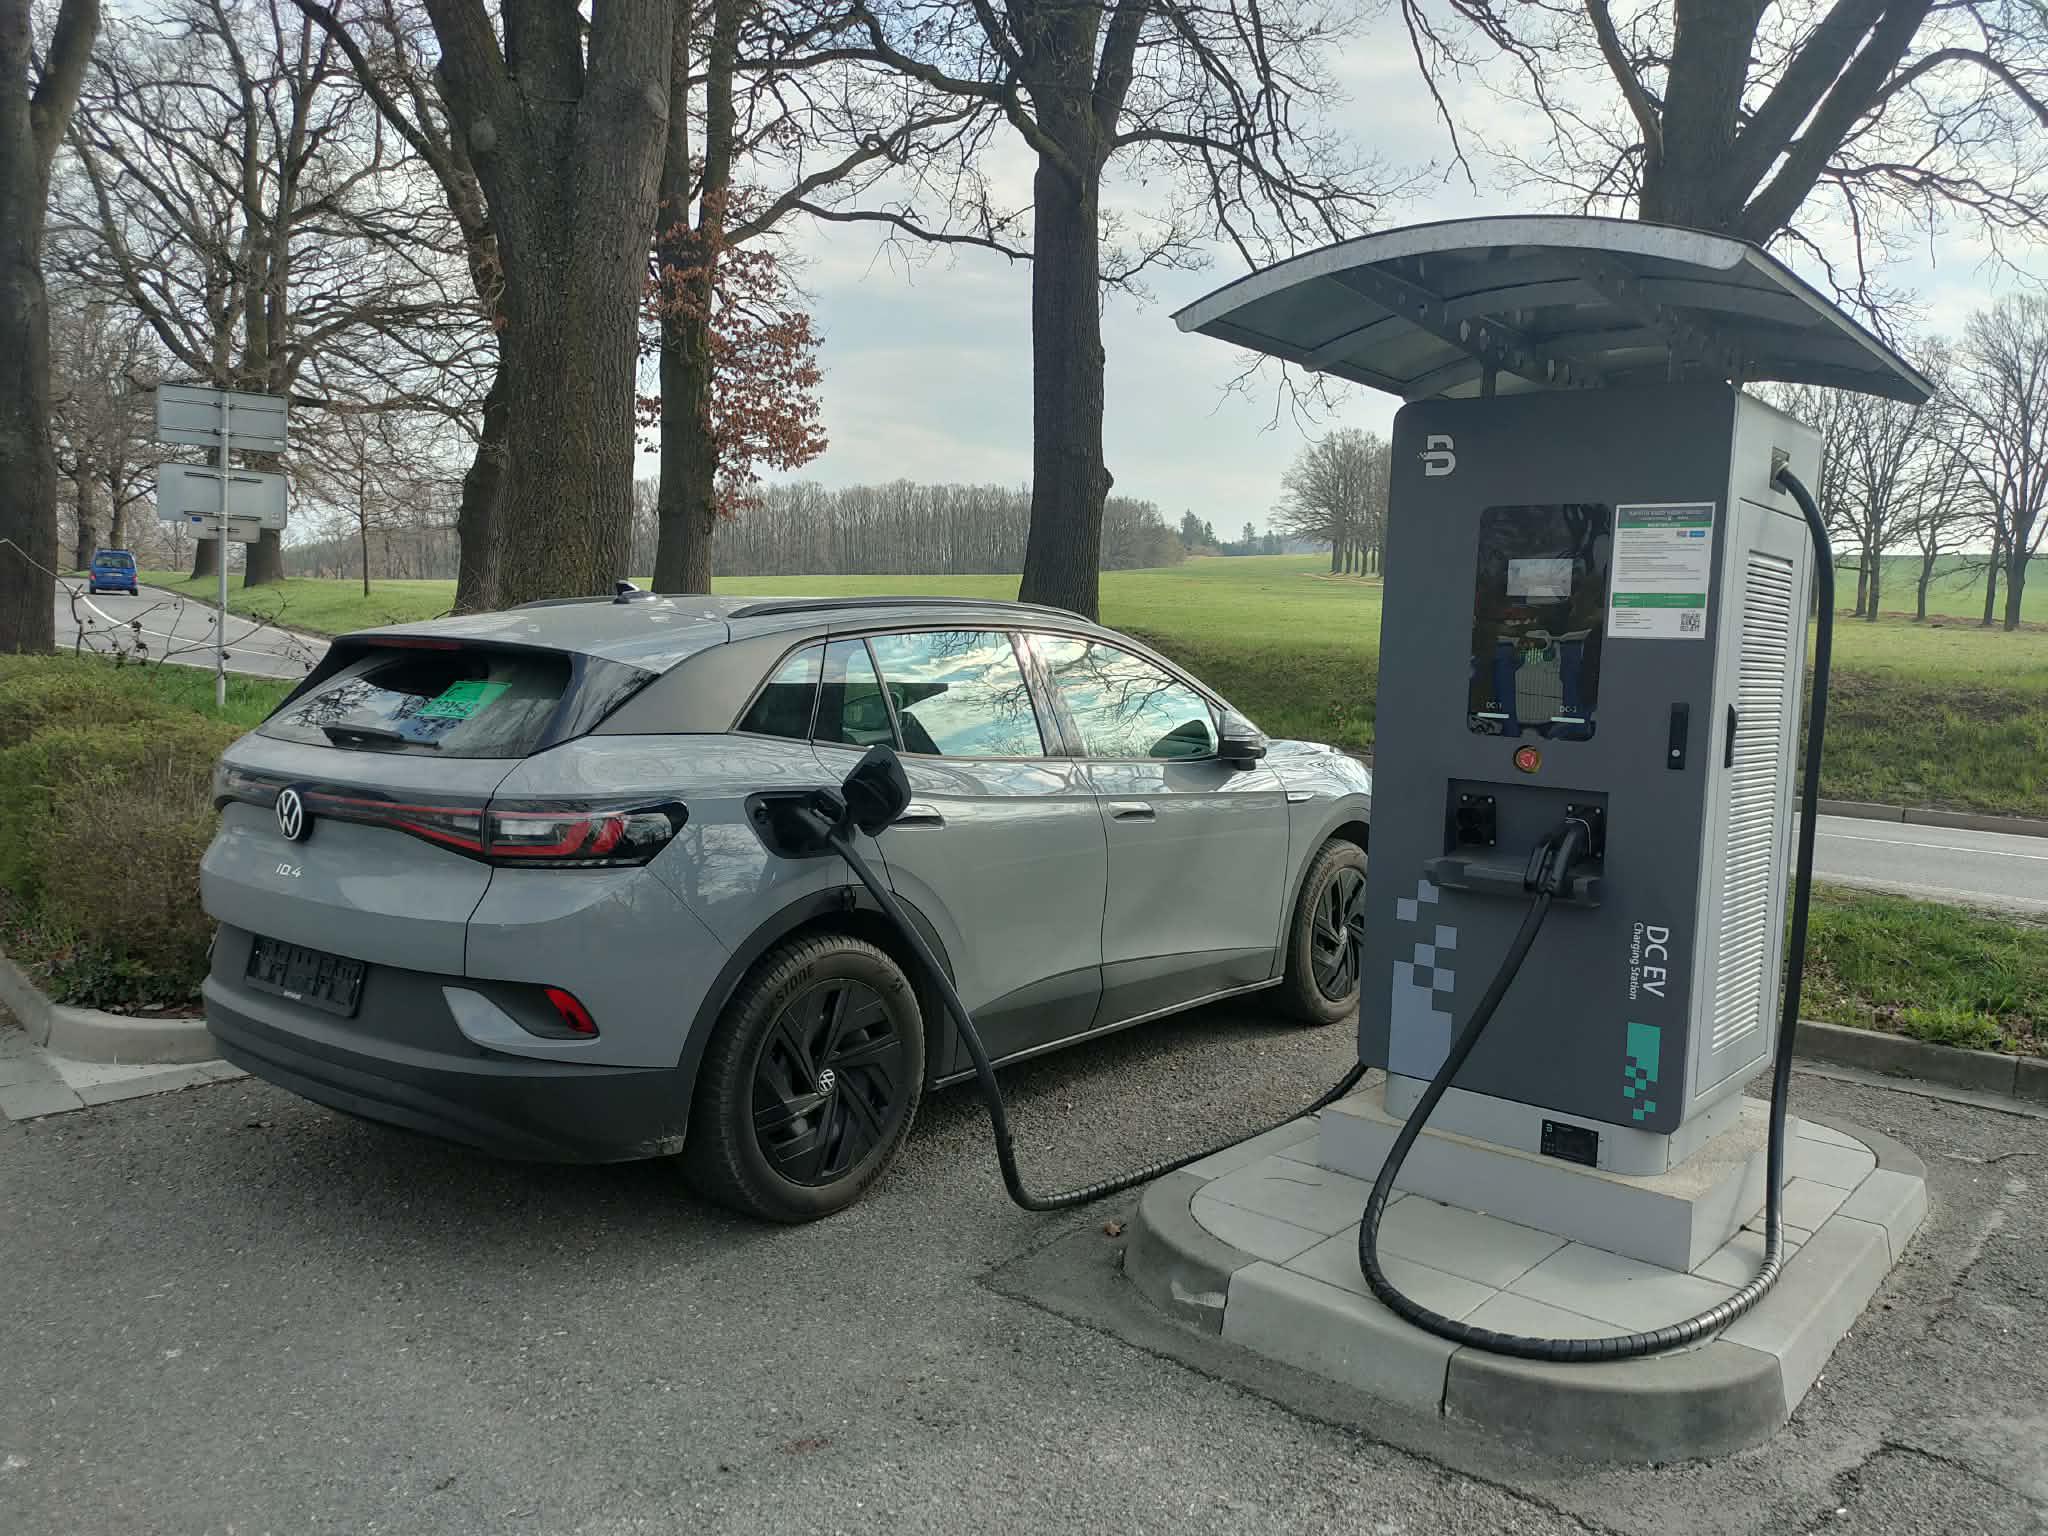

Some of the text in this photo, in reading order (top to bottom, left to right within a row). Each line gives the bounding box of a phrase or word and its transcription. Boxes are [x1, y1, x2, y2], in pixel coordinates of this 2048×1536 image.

[1628, 921, 1644, 1000] Charging Station
[1642, 925, 1669, 998] DC EV
